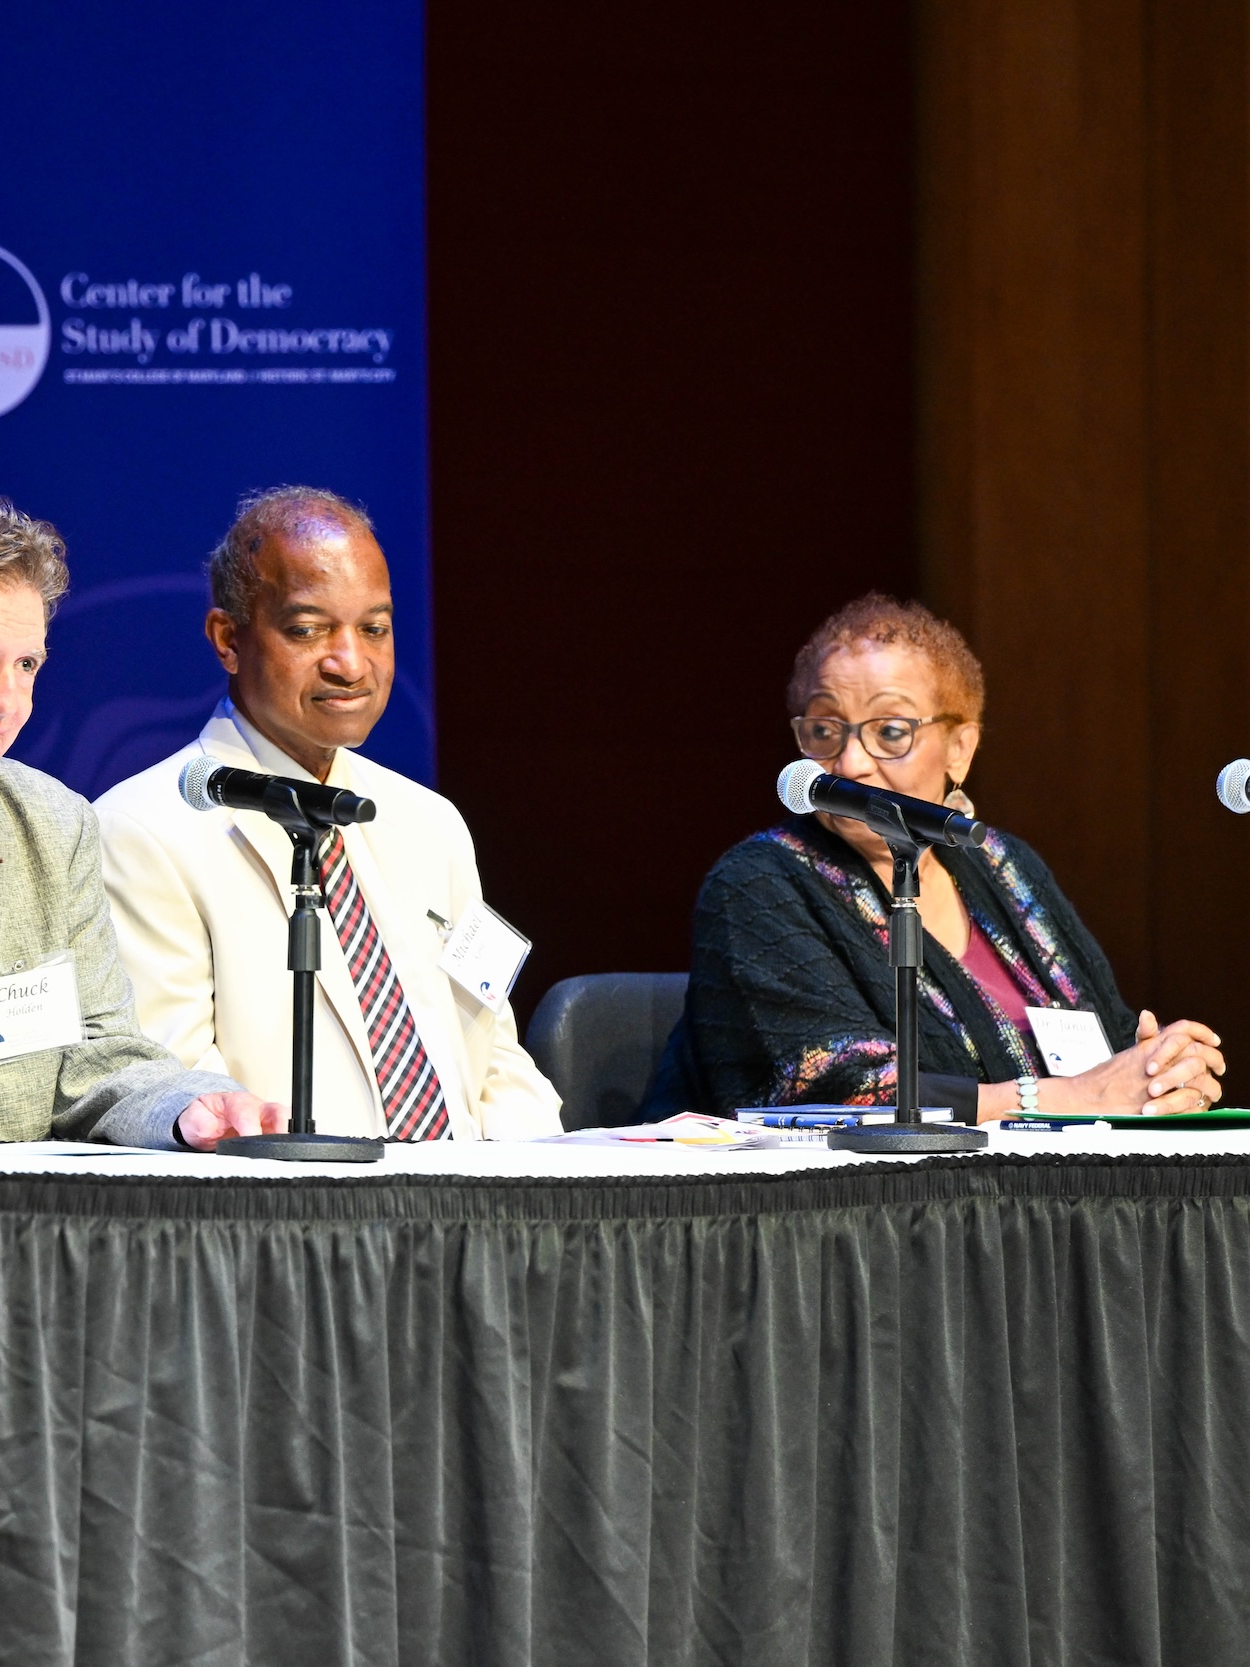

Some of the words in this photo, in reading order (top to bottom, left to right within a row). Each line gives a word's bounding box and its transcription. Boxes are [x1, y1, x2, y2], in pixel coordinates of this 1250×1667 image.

[60, 271, 175, 308] Center
[181, 271, 230, 308] for
[237, 272, 292, 308] the
[61, 317, 160, 364] Study
[166, 317, 206, 354] of
[210, 317, 395, 364] Democracy
[6, 1002, 44, 1018] Holden
